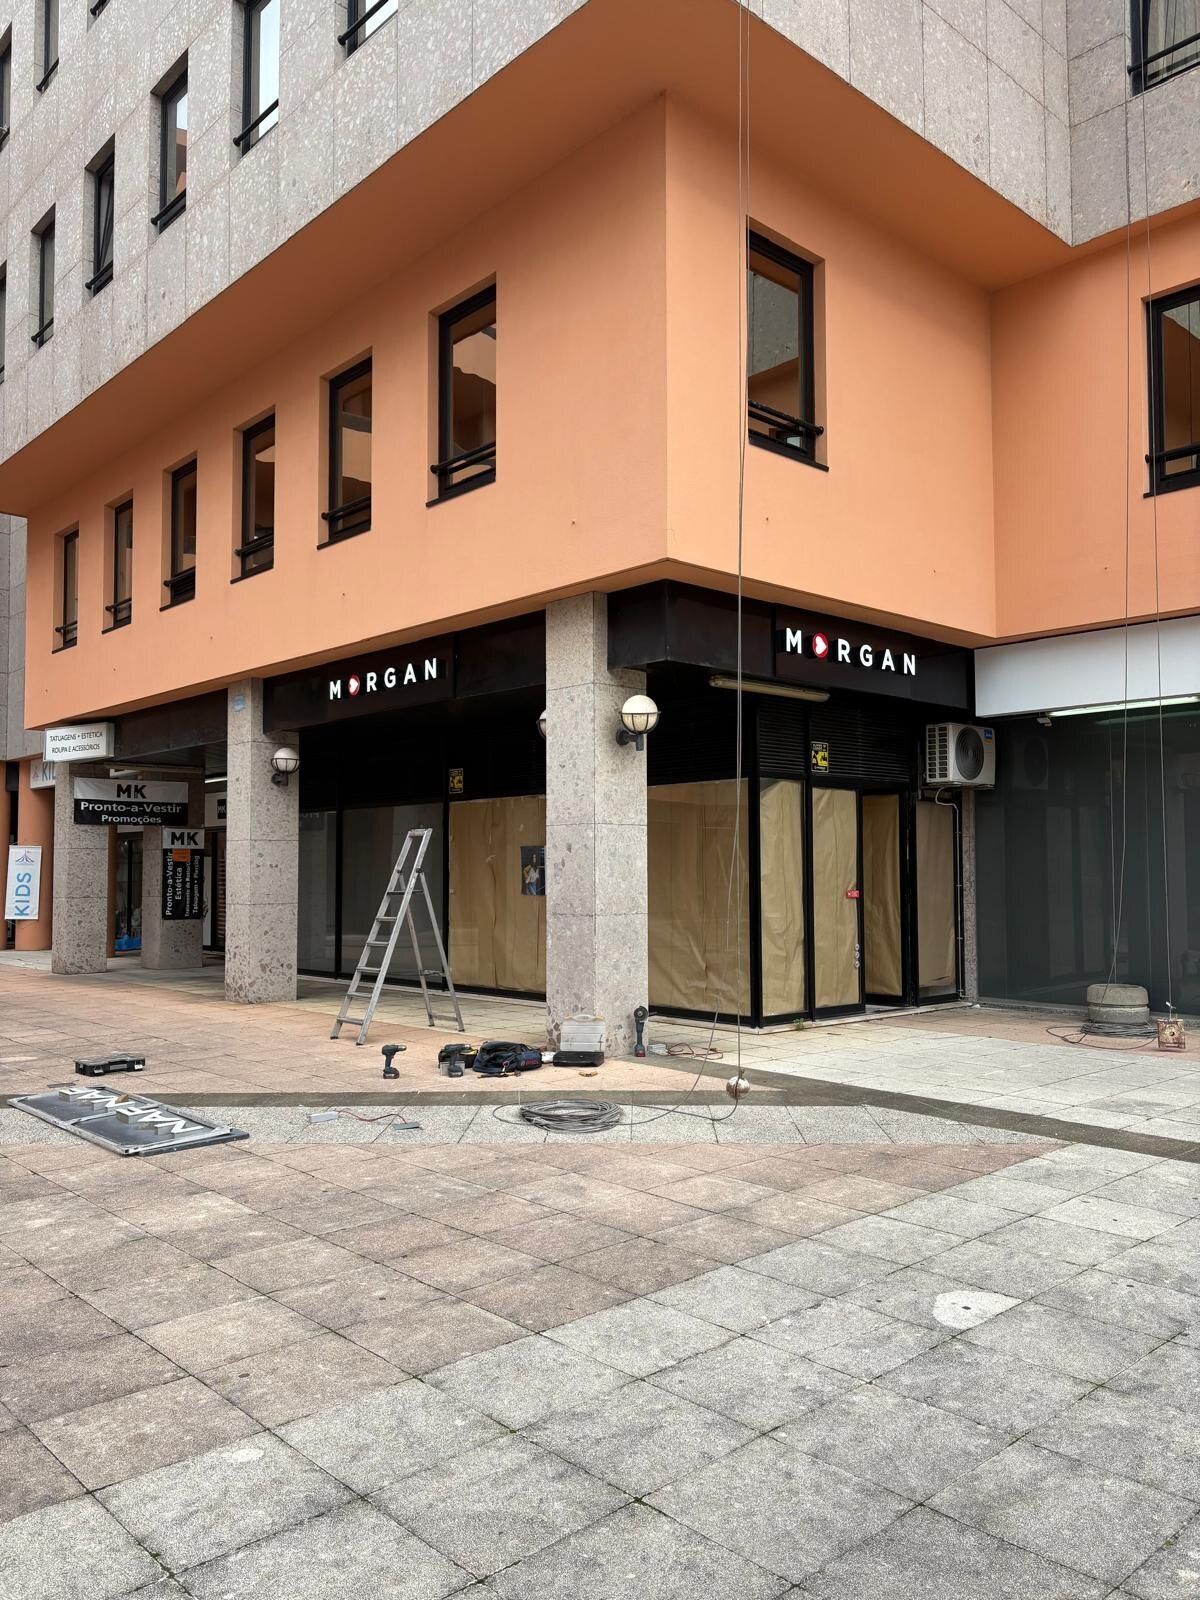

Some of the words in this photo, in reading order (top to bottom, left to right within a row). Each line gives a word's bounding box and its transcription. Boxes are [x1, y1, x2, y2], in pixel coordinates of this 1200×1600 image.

[785, 627, 917, 676] MORGAN
[329, 657, 438, 700] MORGAN
[50, 733, 77, 742] TATUAGENS
[52, 746, 68, 754] ROUPA
[116, 783, 147, 799] MK
[80, 801, 182, 814] Pronto-a-Vestir
[101, 814, 162, 824] Promoções
[170, 831, 199, 846] MK
[165, 852, 174, 916] Pronto-a-Vestir
[174, 867, 183, 900] Estética
[14, 872, 32, 916] KIDS
